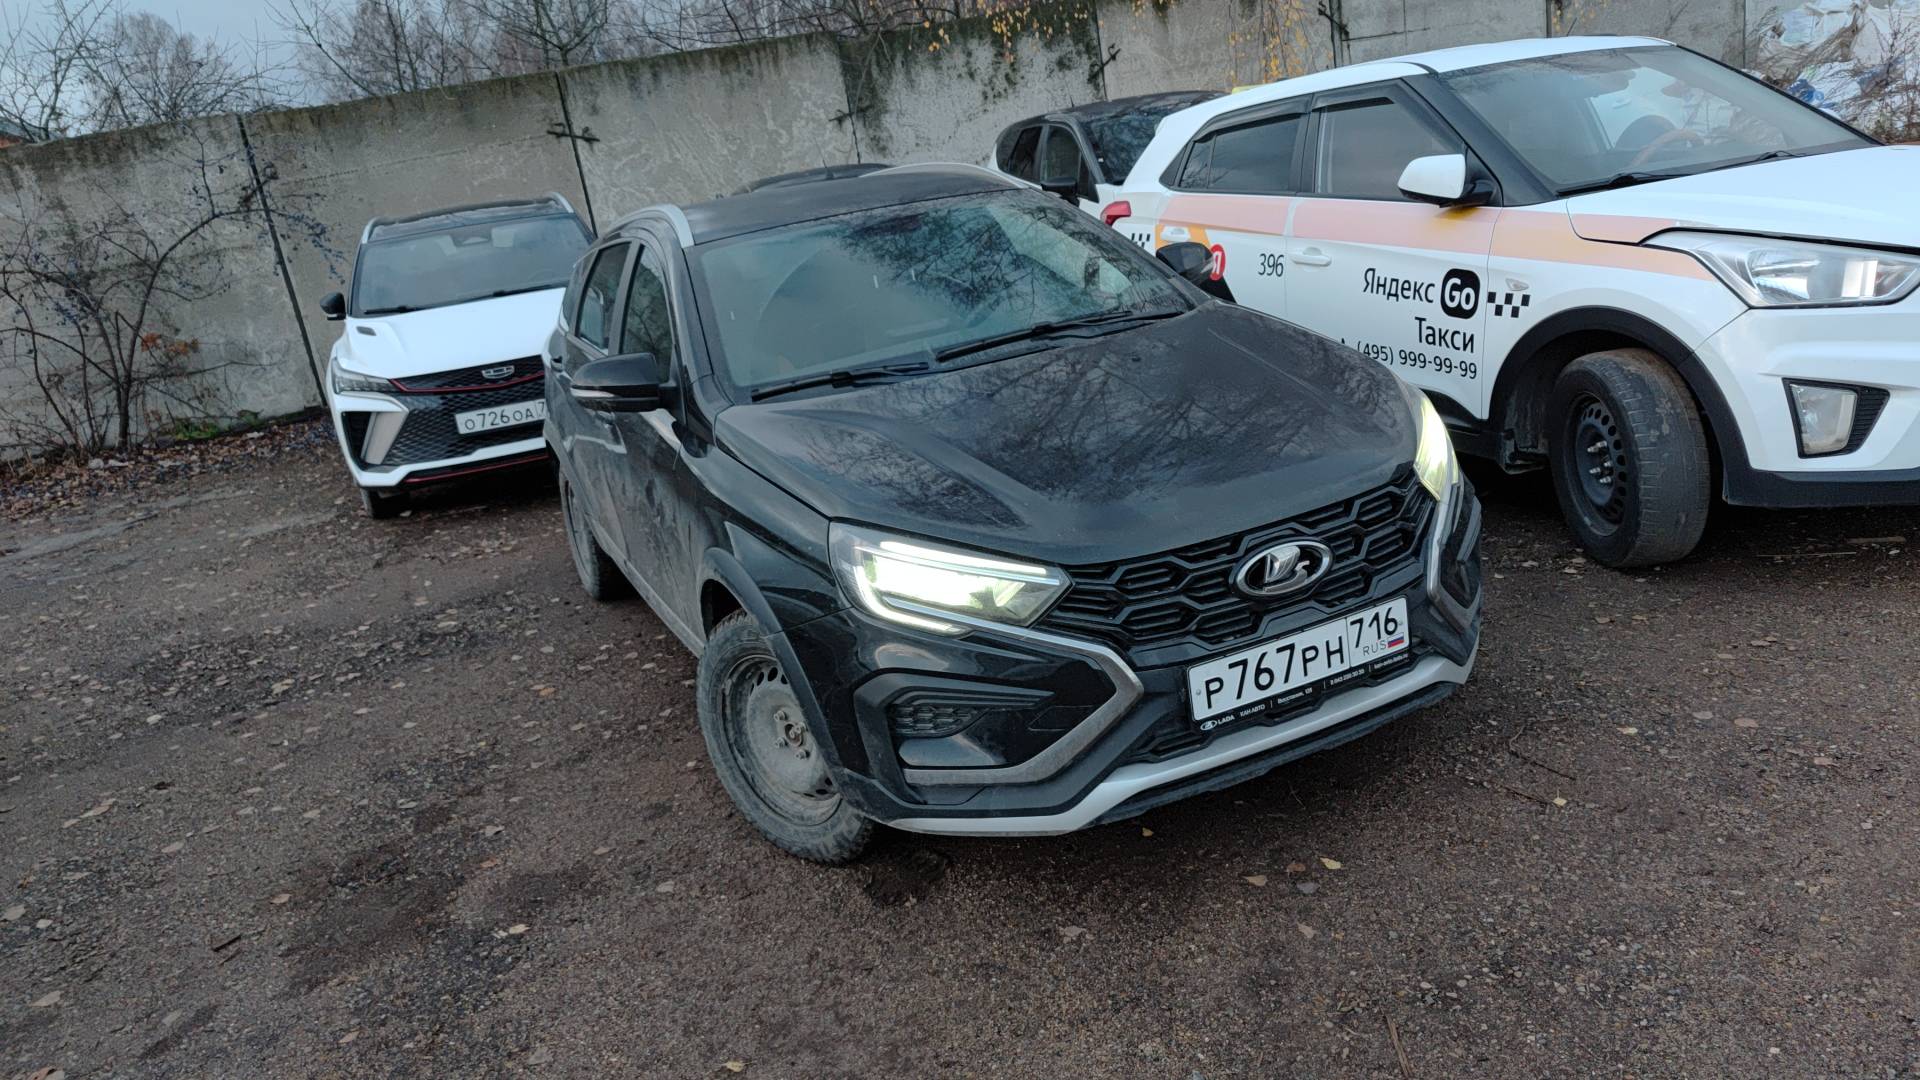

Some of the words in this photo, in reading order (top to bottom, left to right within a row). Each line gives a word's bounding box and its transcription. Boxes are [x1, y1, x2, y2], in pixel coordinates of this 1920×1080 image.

[1257, 253, 1284, 277] 396
[1362, 267, 1436, 304] Яндекс
[1444, 277, 1475, 311] Go
[1414, 316, 1475, 354] Такси
[1357, 340, 1394, 365] (495)
[1398, 349, 1477, 380] 999-99-99
[1204, 635, 1345, 709] Р767РН
[1350, 606, 1398, 649] 716
[1362, 639, 1387, 657] RUS
[1217, 714, 1236, 725] LADA
